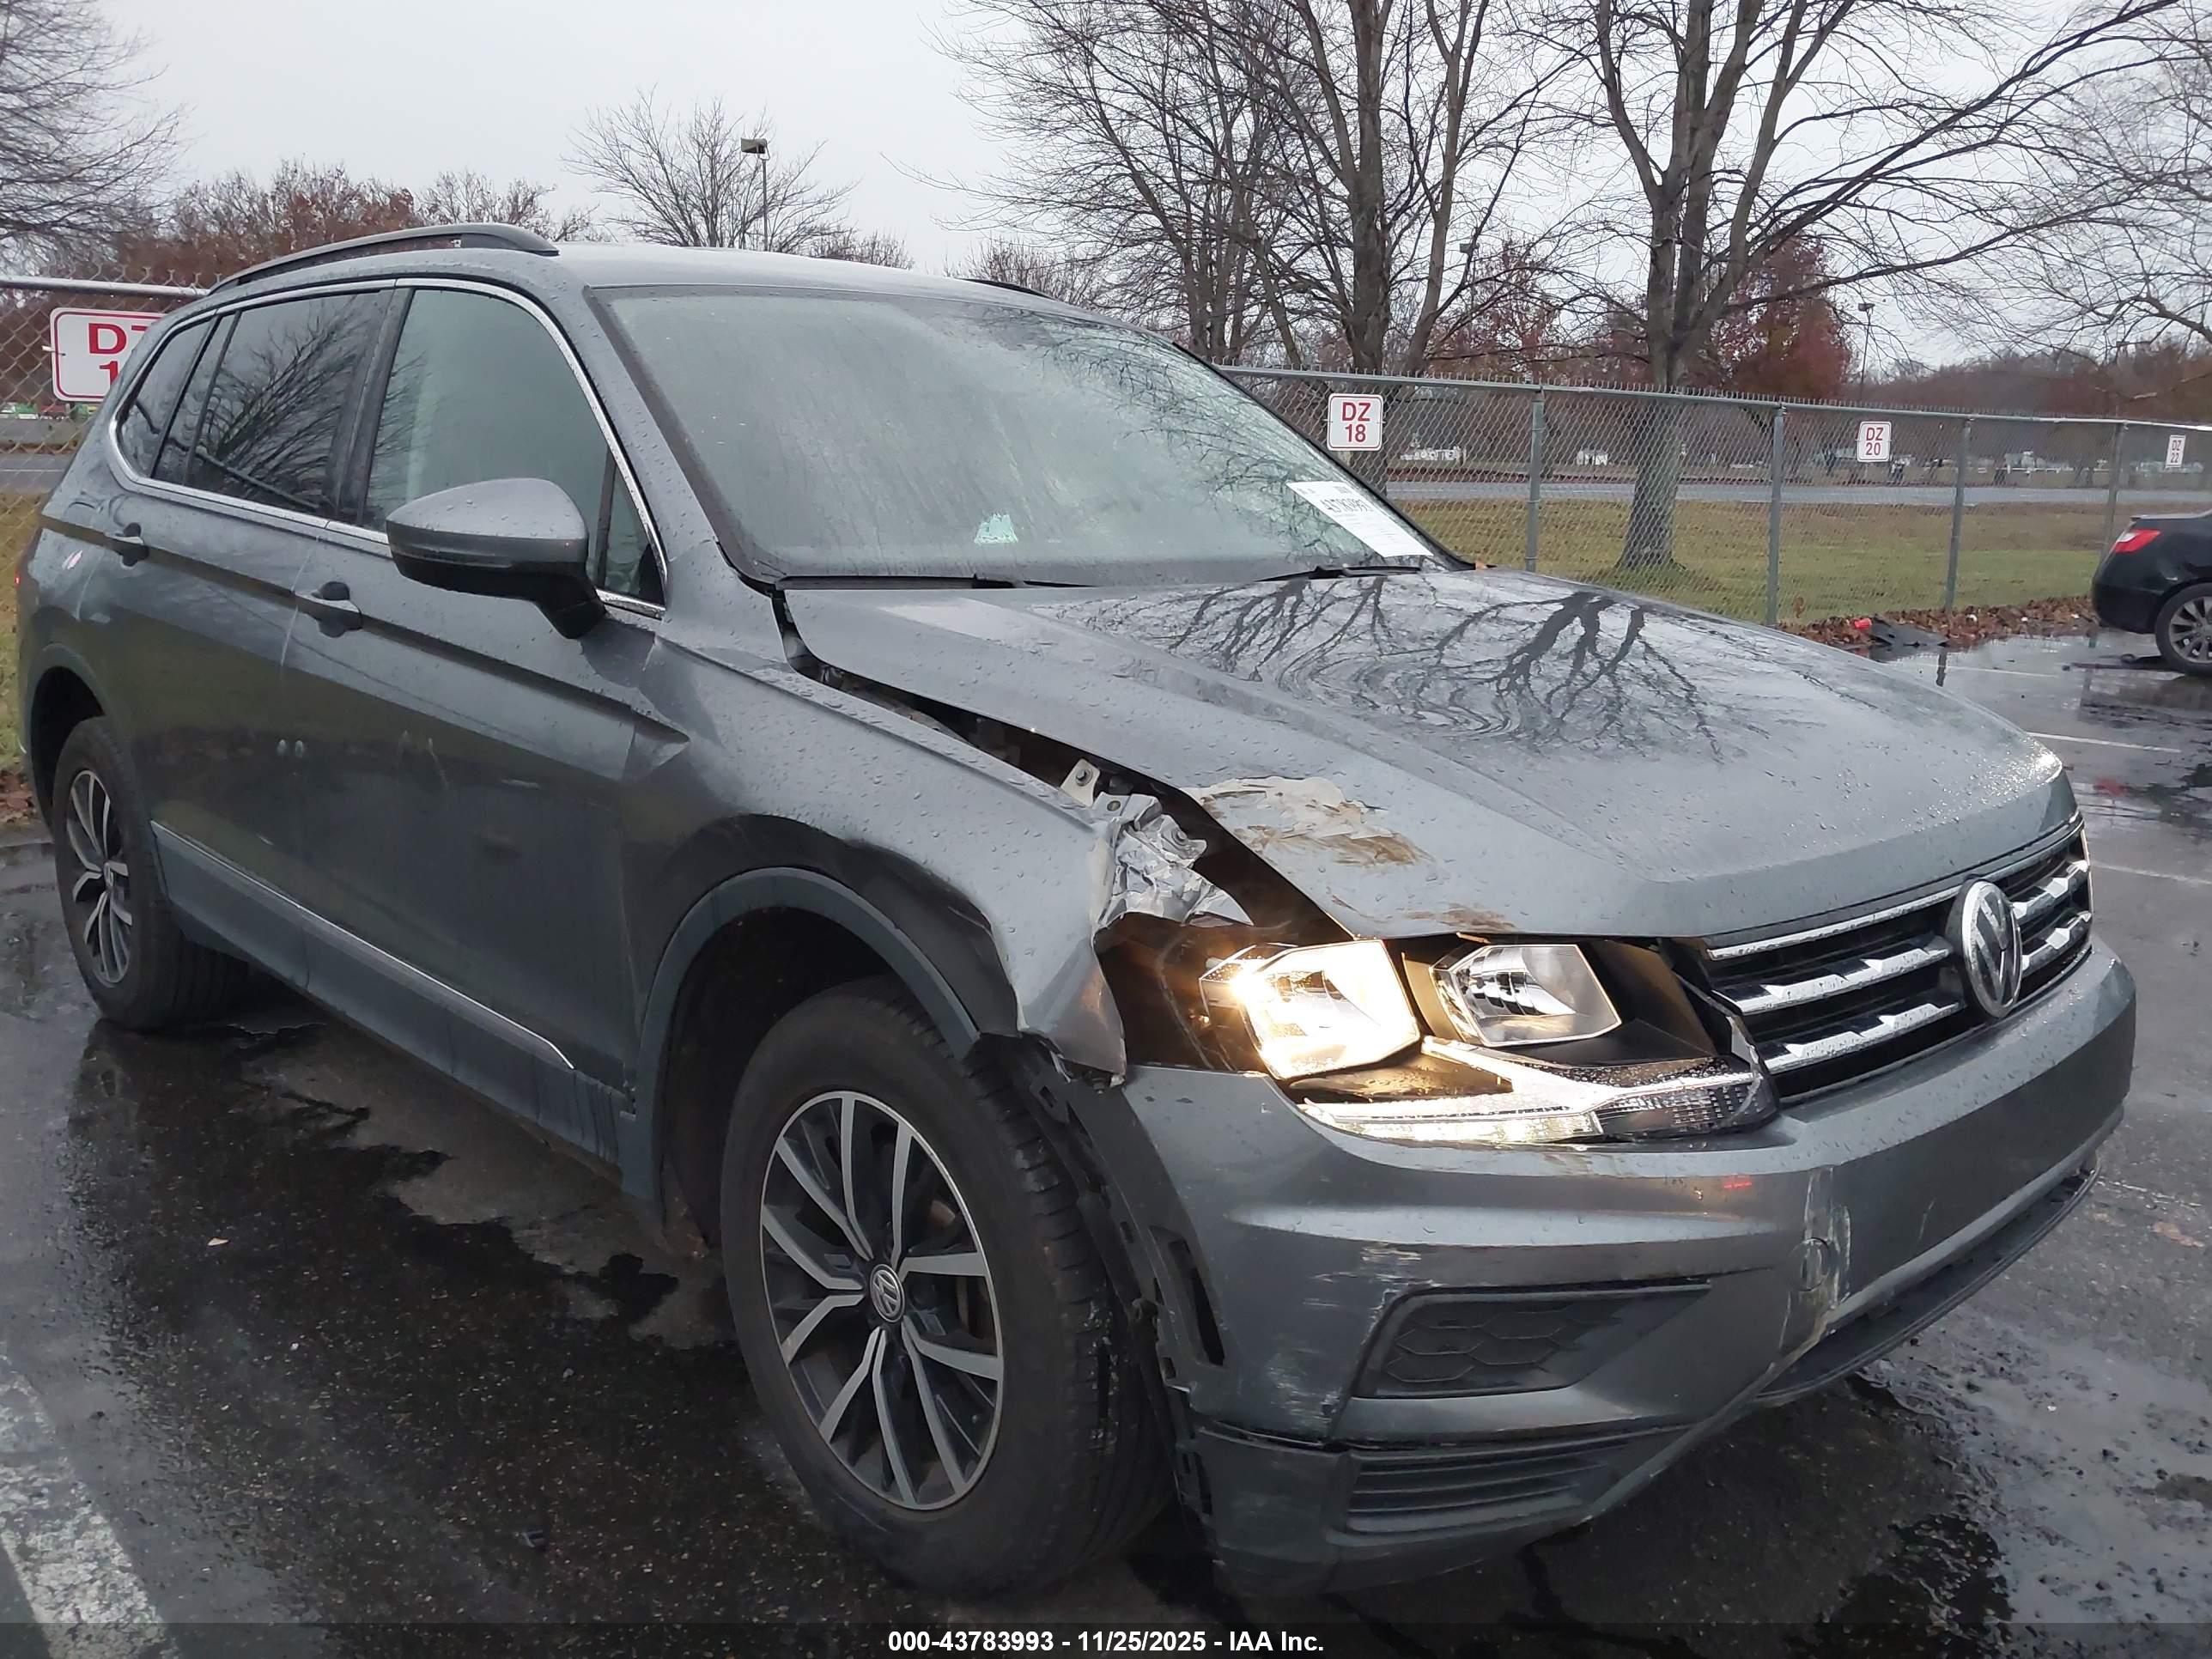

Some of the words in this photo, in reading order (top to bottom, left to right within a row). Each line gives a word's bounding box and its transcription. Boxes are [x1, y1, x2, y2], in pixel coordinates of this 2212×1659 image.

[99, 361, 118, 386] 1
[1341, 402, 1371, 422] DZ
[1345, 424, 1367, 443] 18
[1866, 427, 1884, 441] DZ
[1865, 442, 1881, 456] 20
[2170, 453, 2179, 464] 22
